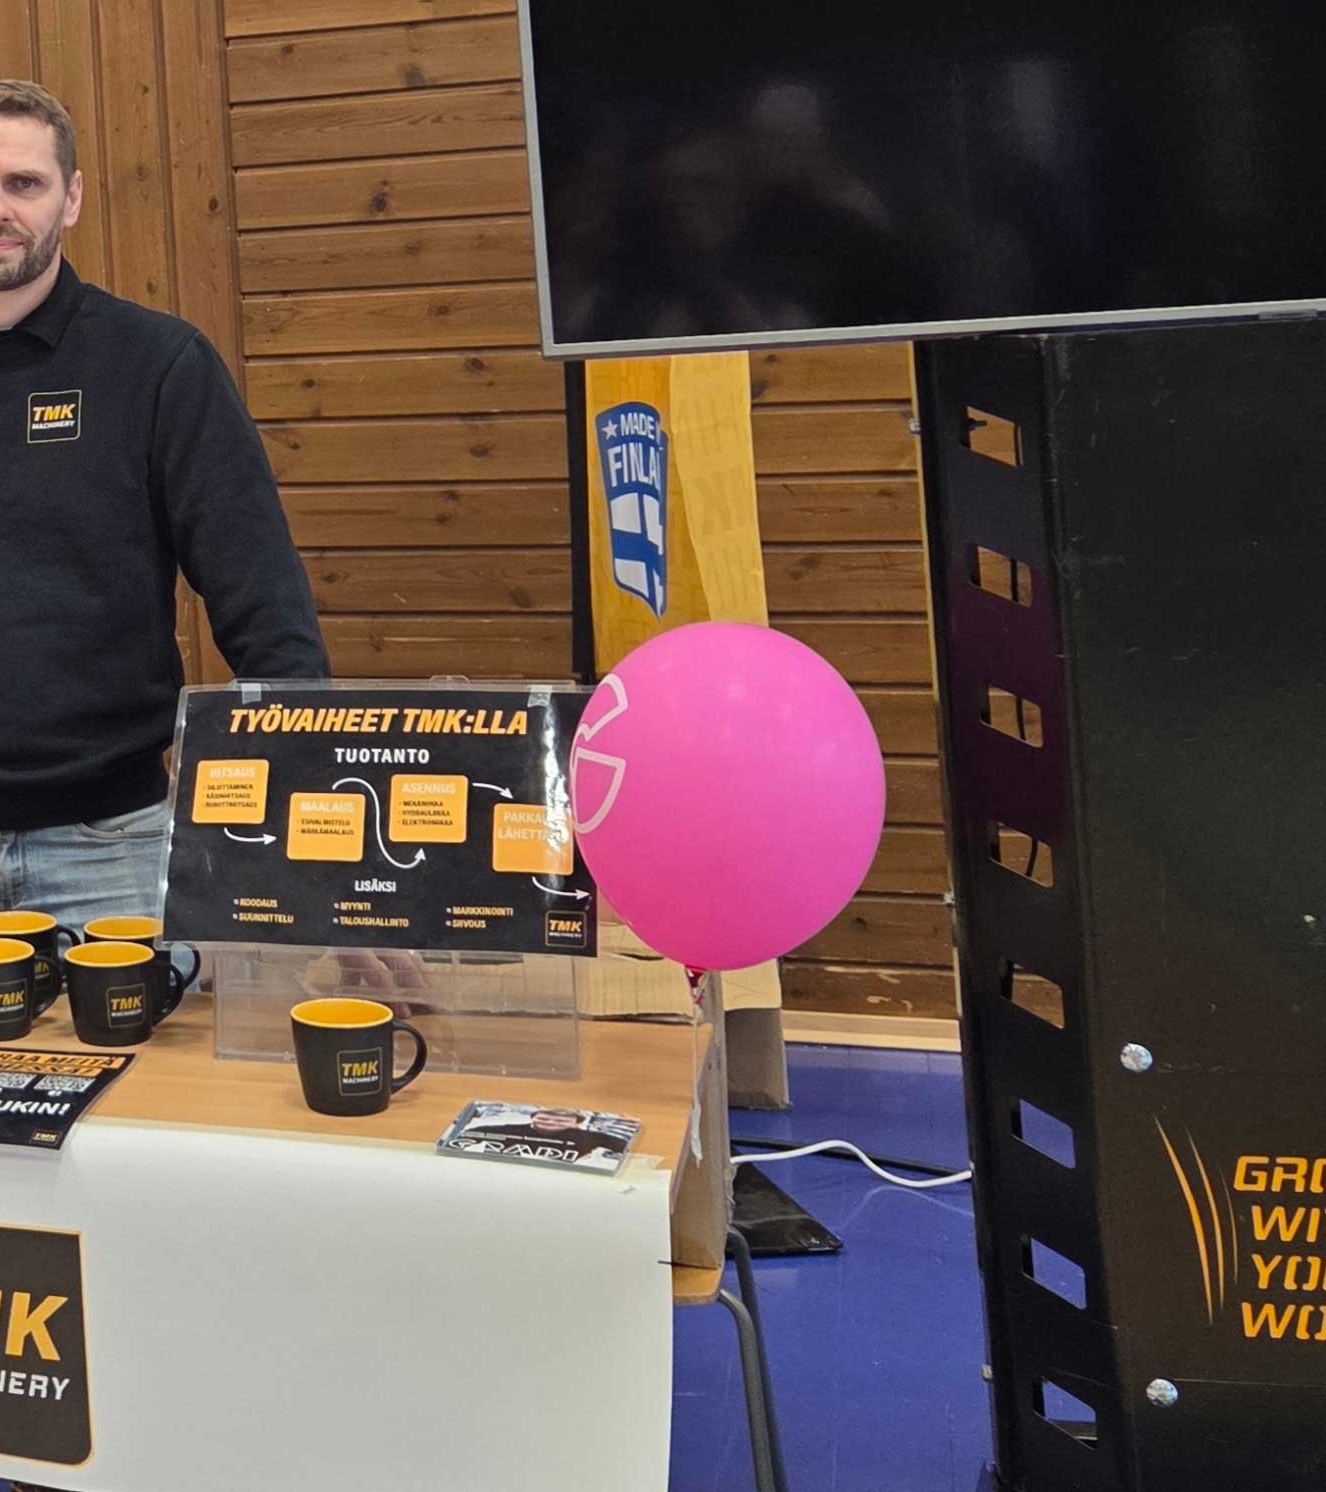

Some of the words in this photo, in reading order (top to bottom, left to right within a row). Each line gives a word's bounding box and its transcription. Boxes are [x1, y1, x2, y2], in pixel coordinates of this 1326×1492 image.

[33, 403, 76, 422] TMK
[620, 412, 655, 440] MADE
[607, 442, 662, 494] FINLA
[230, 704, 399, 733] TYÖVAIHEET
[402, 709, 528, 735] TMK:LLA
[334, 748, 430, 764] TUOTANTO
[209, 767, 257, 778] HITSAUS
[402, 782, 457, 795] ASENNUS
[300, 800, 355, 813] MAALAUS
[354, 878, 397, 893] LISÄKSI
[239, 898, 278, 908] KOODAUS
[339, 902, 372, 912] MYYNTI
[452, 905, 514, 917] MARKKINOINTI
[339, 916, 410, 928] TALOUSHALLINTO
[451, 919, 487, 929] SIIVOUS
[548, 919, 583, 933] TMK
[110, 995, 142, 1010] TMK
[342, 1060, 379, 1077] TMK
[1251, 1205, 1326, 1243] WI
[1251, 1253, 1326, 1292] YO
[1241, 1301, 1326, 1341] WO
